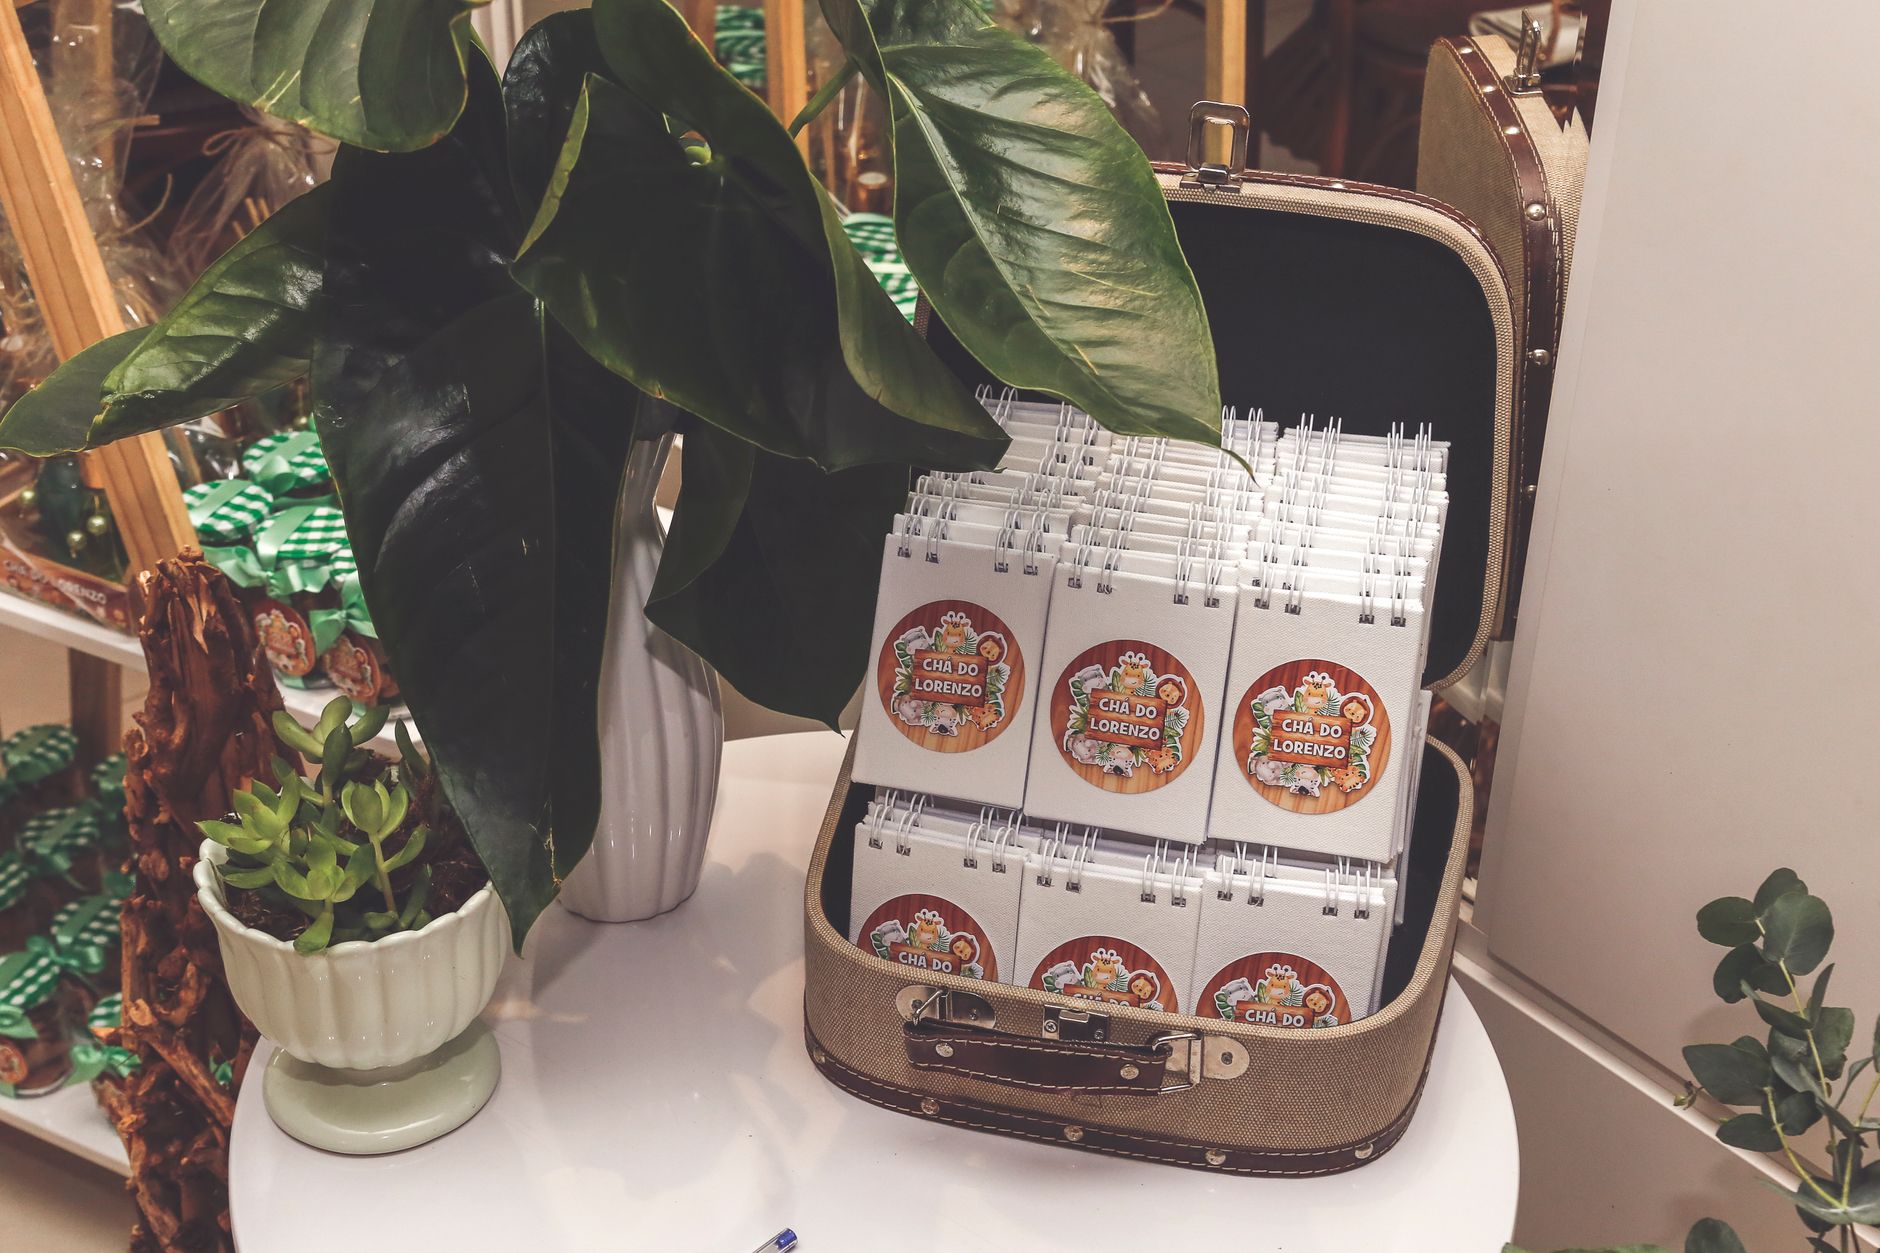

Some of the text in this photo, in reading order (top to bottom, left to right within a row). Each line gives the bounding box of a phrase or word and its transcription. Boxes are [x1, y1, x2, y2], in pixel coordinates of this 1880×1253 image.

[922, 656, 979, 676] CHÁ DO
[914, 678, 983, 698] LORENZO
[1098, 697, 1157, 719] CHÁ DO
[1090, 717, 1160, 741] LORENZO
[1281, 717, 1342, 738] CHÁ DO
[1273, 738, 1346, 759] LORENZO
[898, 951, 952, 973] CHÁ DO
[1245, 1007, 1305, 1027] CHÁ DO
